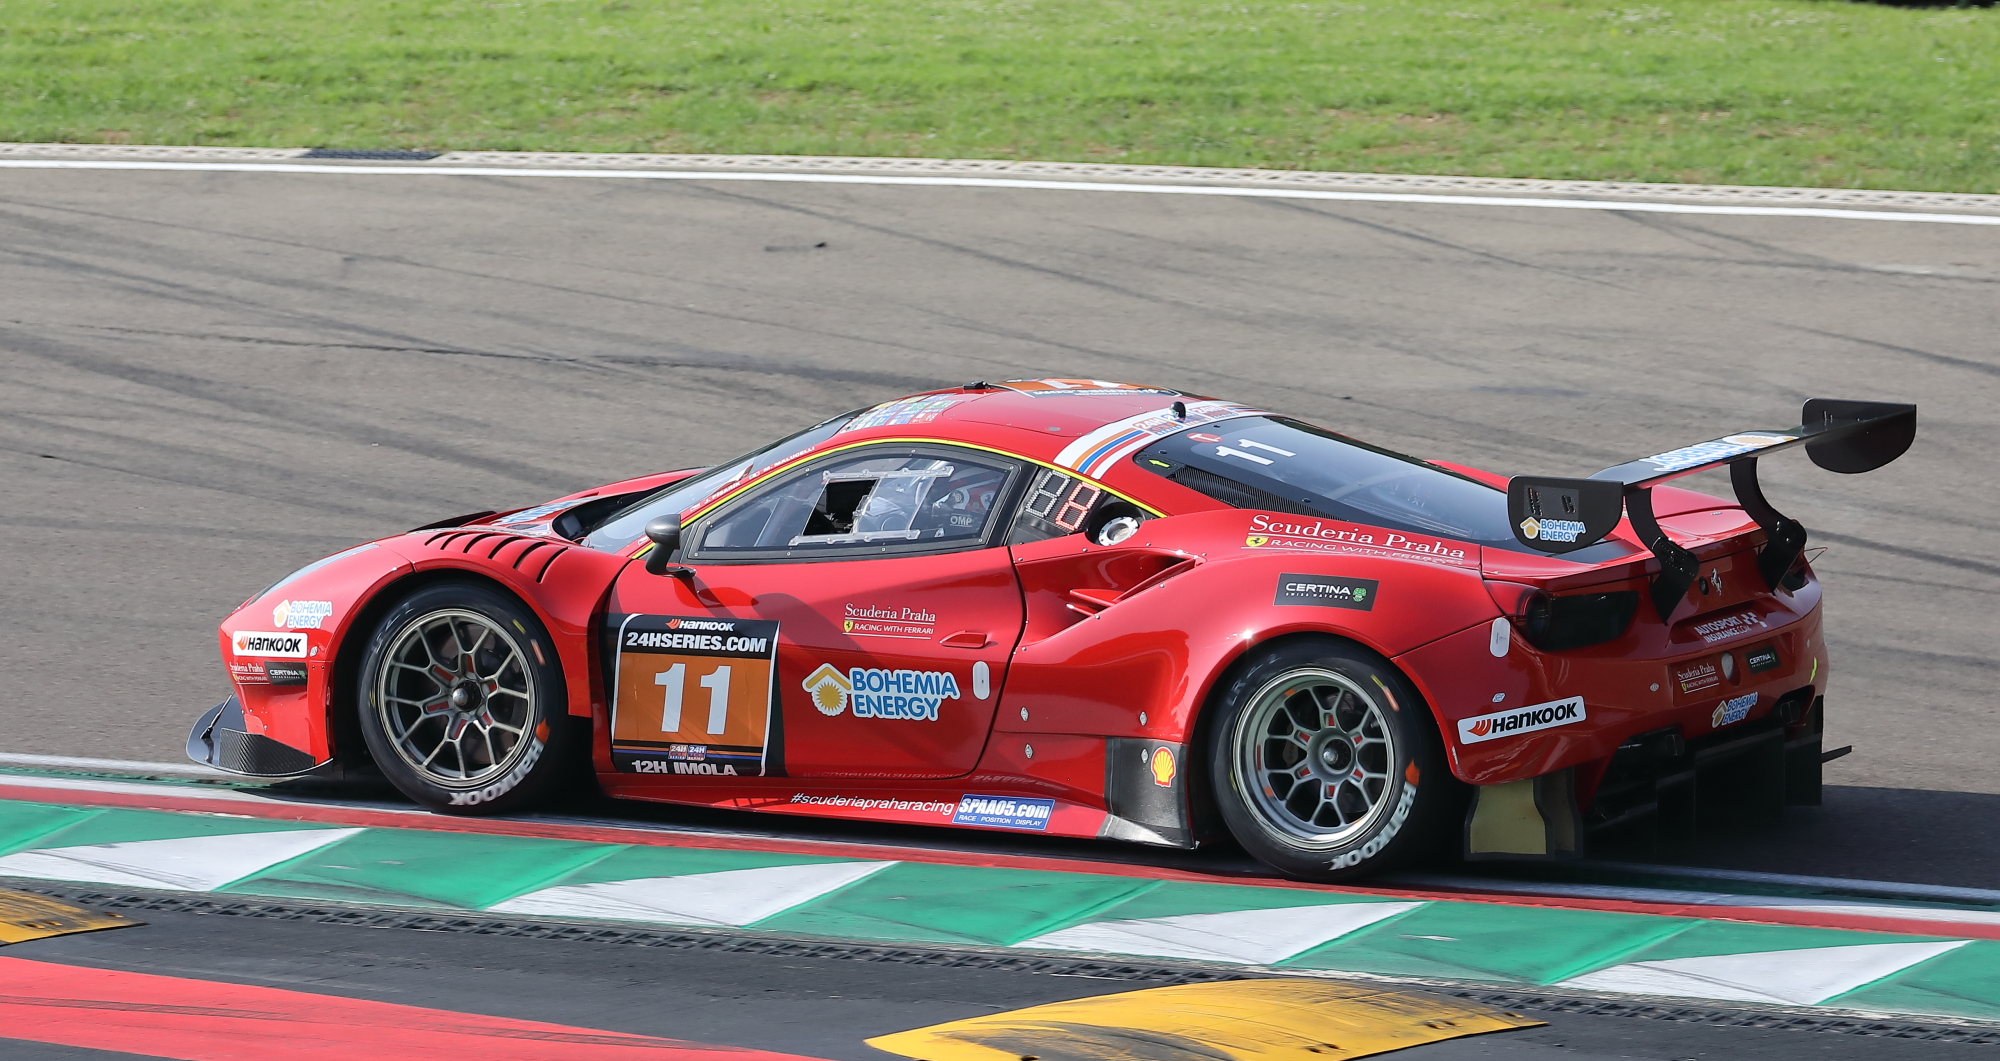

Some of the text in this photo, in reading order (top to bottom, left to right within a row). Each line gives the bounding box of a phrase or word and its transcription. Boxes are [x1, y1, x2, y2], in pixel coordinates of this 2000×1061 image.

[1215, 438, 1297, 466] 11
[950, 515, 972, 526] OMP
[1541, 520, 1585, 532] BOHEMIA
[1250, 514, 1465, 558] Scuderia Praha
[1541, 530, 1577, 541] ENERGY
[1271, 539, 1337, 550] RACING
[1341, 545, 1388, 556] WITH
[1286, 583, 1351, 595] CERTINA
[290, 602, 331, 615] BOHEMIA
[844, 603, 936, 622] Scuderia Praha
[288, 614, 322, 627] ENERGY
[854, 623, 934, 635] RACING WITH FERRARI
[1694, 616, 1743, 635] AUTOSPORT
[626, 632, 768, 653] 24HSERIES.COM
[1749, 653, 1771, 665] CERTINA
[1677, 662, 1716, 681] Scuderia Praha
[852, 670, 958, 696] BOHEMIA
[654, 663, 732, 735] 11
[854, 694, 939, 718] ENERGY
[1727, 692, 1758, 711] BOHEMIA
[1722, 707, 1749, 725] ENERGY
[670, 745, 687, 753] 24H
[689, 746, 705, 754] 24H
[631, 759, 739, 776] 12H IMOLA
[790, 792, 955, 816] #scuderiapraharacing
[959, 798, 1050, 818] SPAA05.com
[980, 816, 1012, 824] POSITION
[1015, 818, 1042, 826] DISPLAY
